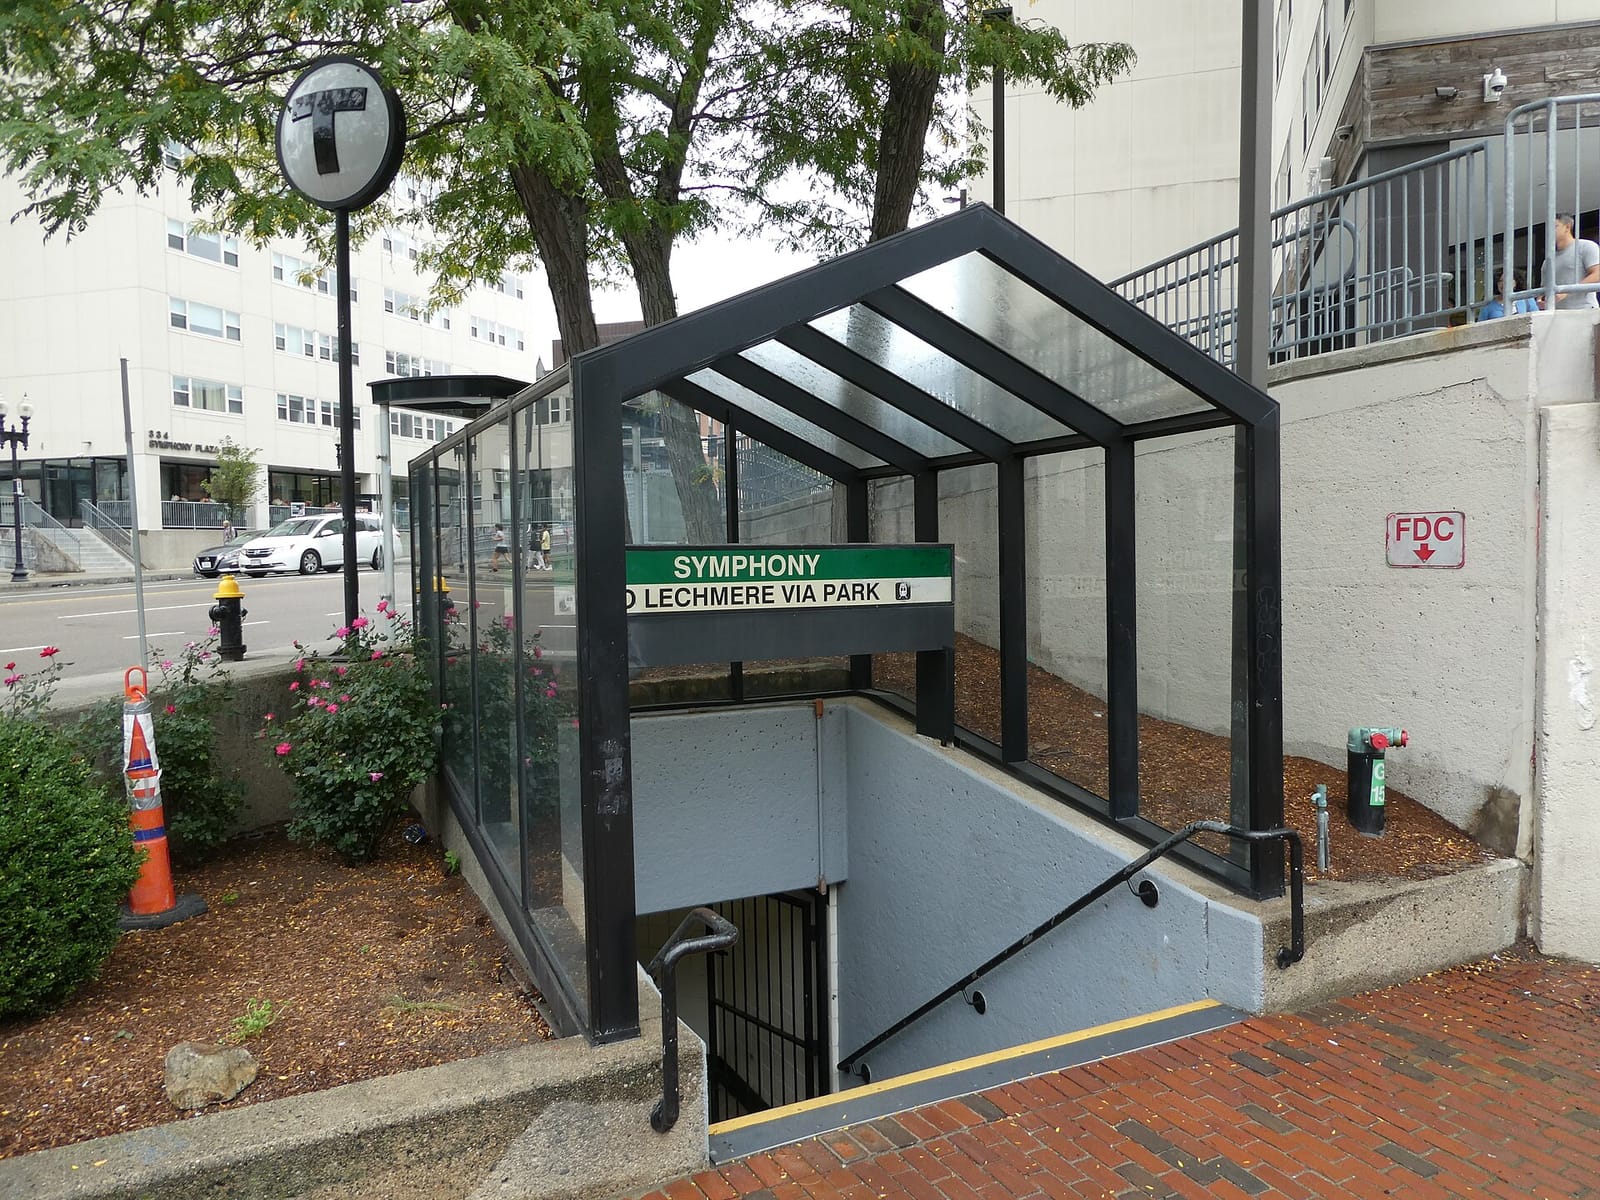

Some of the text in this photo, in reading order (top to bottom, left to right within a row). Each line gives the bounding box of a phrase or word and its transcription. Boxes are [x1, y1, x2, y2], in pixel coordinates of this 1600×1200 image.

[290, 87, 368, 175] T
[148, 430, 169, 440] 334
[148, 440, 193, 452] SYMPHONY
[1396, 516, 1455, 541] FDC
[673, 554, 820, 579] SYMPHONY
[645, 585, 775, 609] LECHMERE
[781, 584, 816, 604] VIA
[823, 582, 880, 603] PARK
